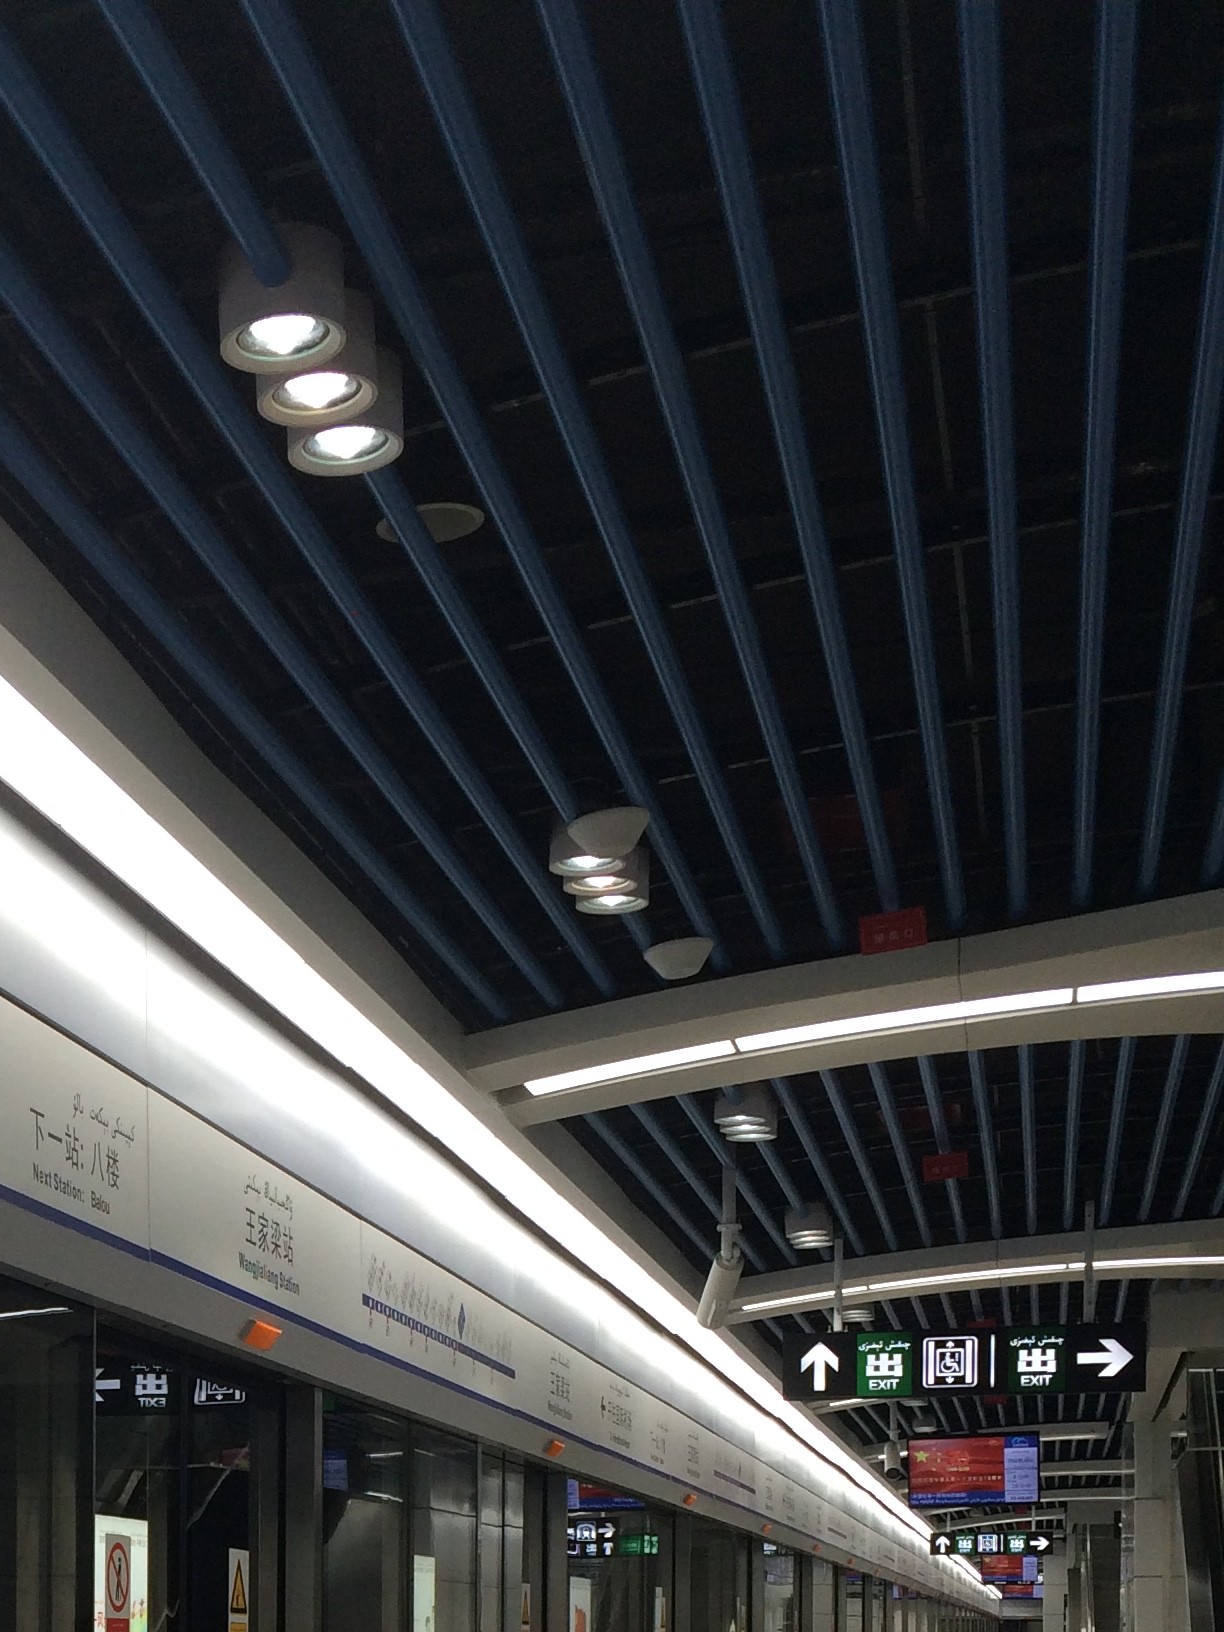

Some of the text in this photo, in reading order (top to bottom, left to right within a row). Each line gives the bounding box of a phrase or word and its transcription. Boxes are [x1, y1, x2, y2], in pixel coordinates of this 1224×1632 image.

[32, 1162, 110, 1215] Next Station: Balou
[245, 1206, 294, 1268] 王家梁站
[279, 1271, 300, 1296] Station
[866, 1353, 903, 1377] 出
[1017, 1348, 1056, 1373] 出
[869, 1378, 900, 1391] EXIT
[1020, 1374, 1053, 1387] EXIT
